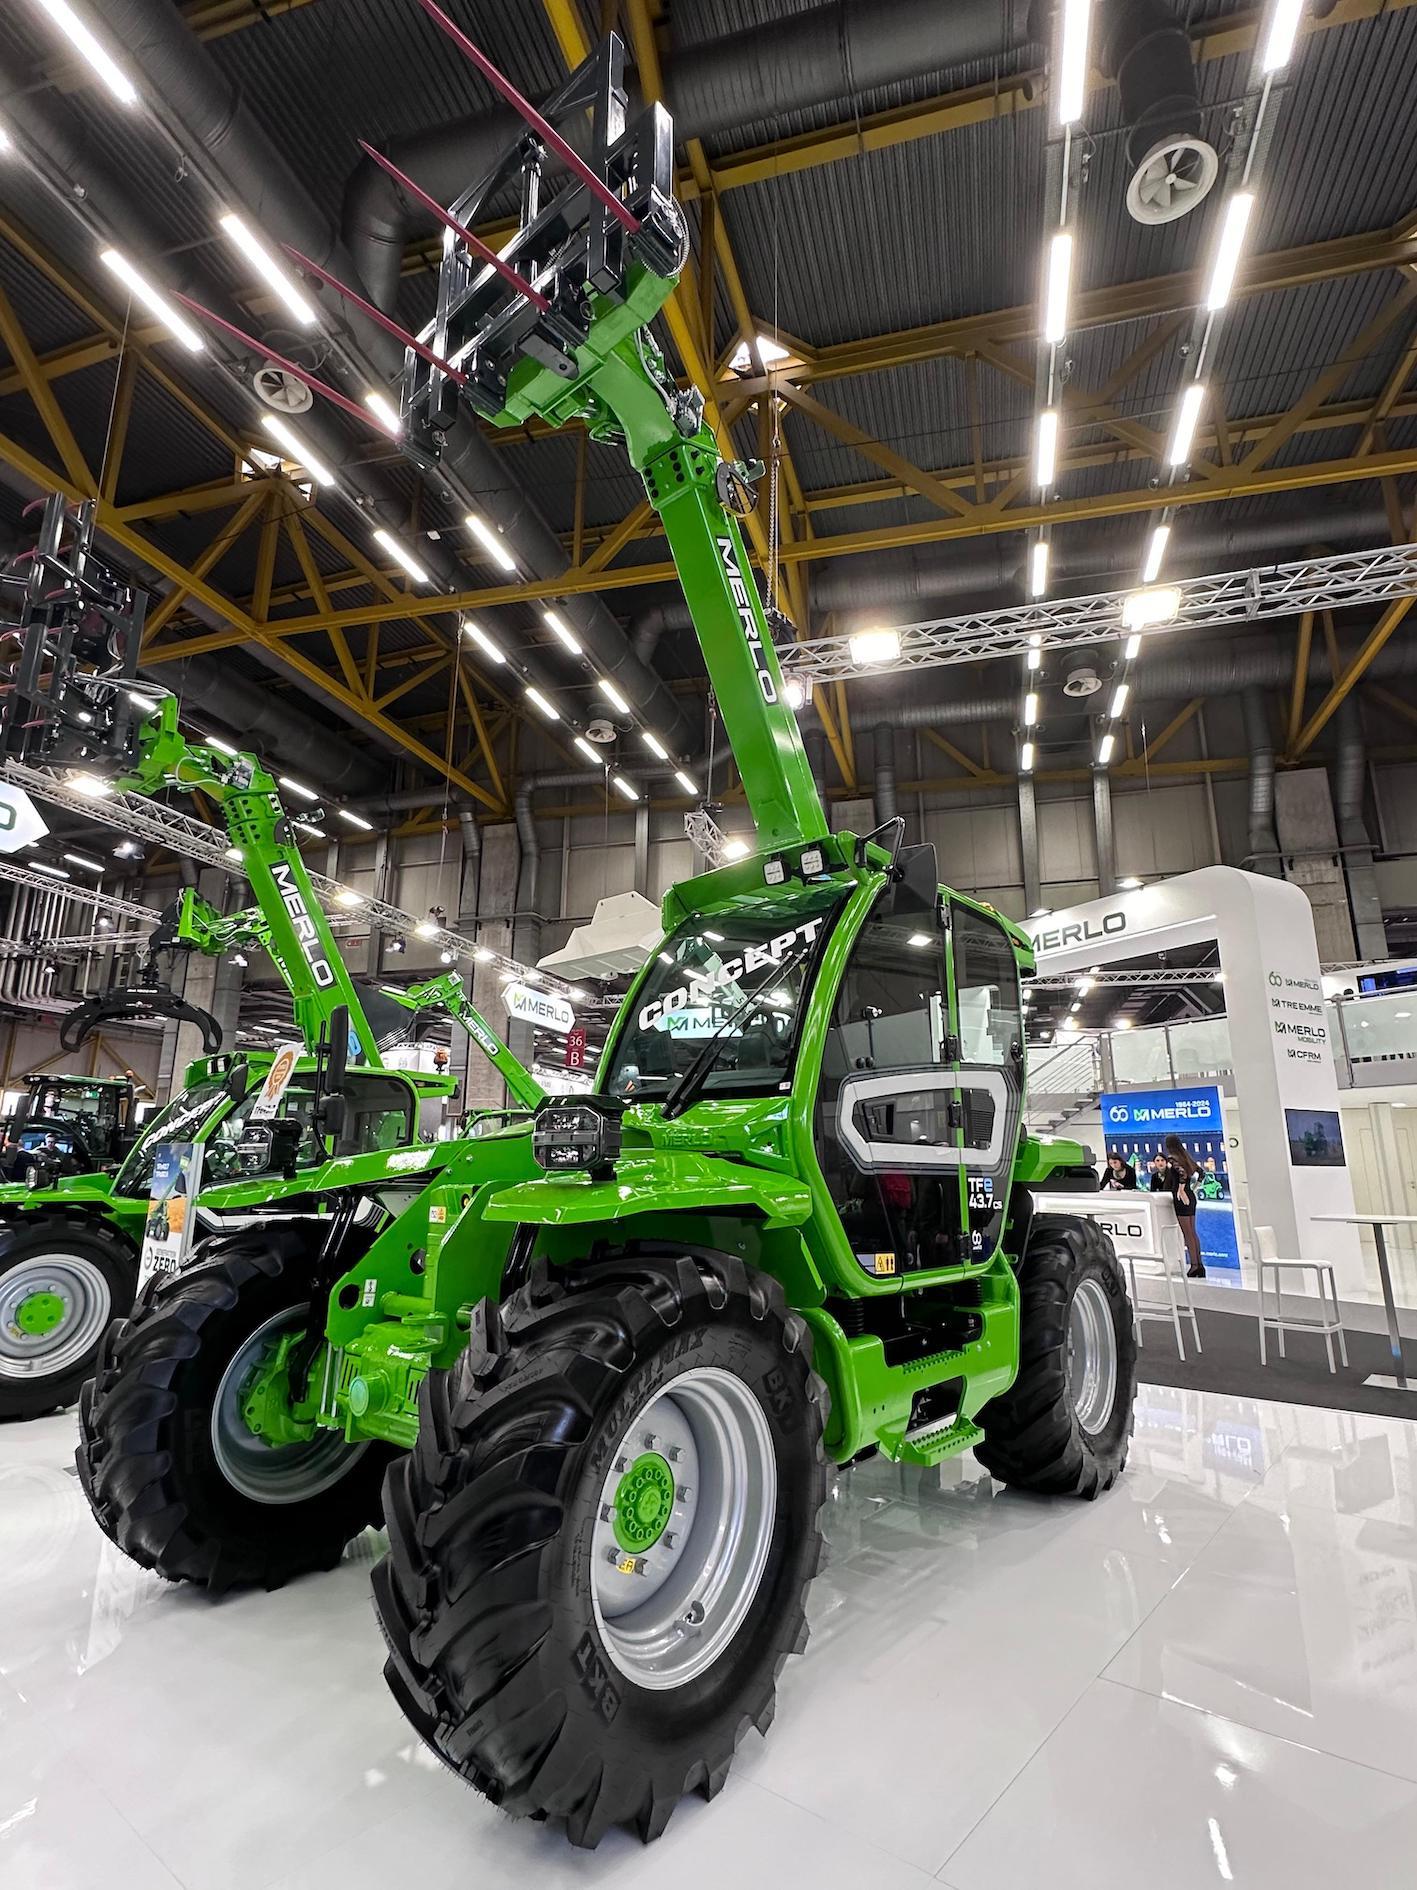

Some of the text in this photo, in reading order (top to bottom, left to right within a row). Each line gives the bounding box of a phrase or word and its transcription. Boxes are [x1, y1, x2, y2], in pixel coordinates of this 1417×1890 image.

[717, 538, 778, 703] MERLO
[271, 864, 334, 987] MERLO
[638, 917, 823, 1031] CONCEPT
[1294, 981, 1319, 991] MERLO
[528, 998, 569, 1024] MERLO
[459, 1010, 499, 1055] MERLO
[1287, 1024, 1326, 1038] MERLO
[569, 1035, 583, 1047] 36
[570, 1051, 580, 1066] B
[1296, 1050, 1321, 1060] CFRM
[1151, 1106, 1212, 1120] MERLO
[968, 1177, 993, 1193] TFe
[1101, 1223, 1143, 1237] RLO
[153, 1255, 176, 1273] ZERO
